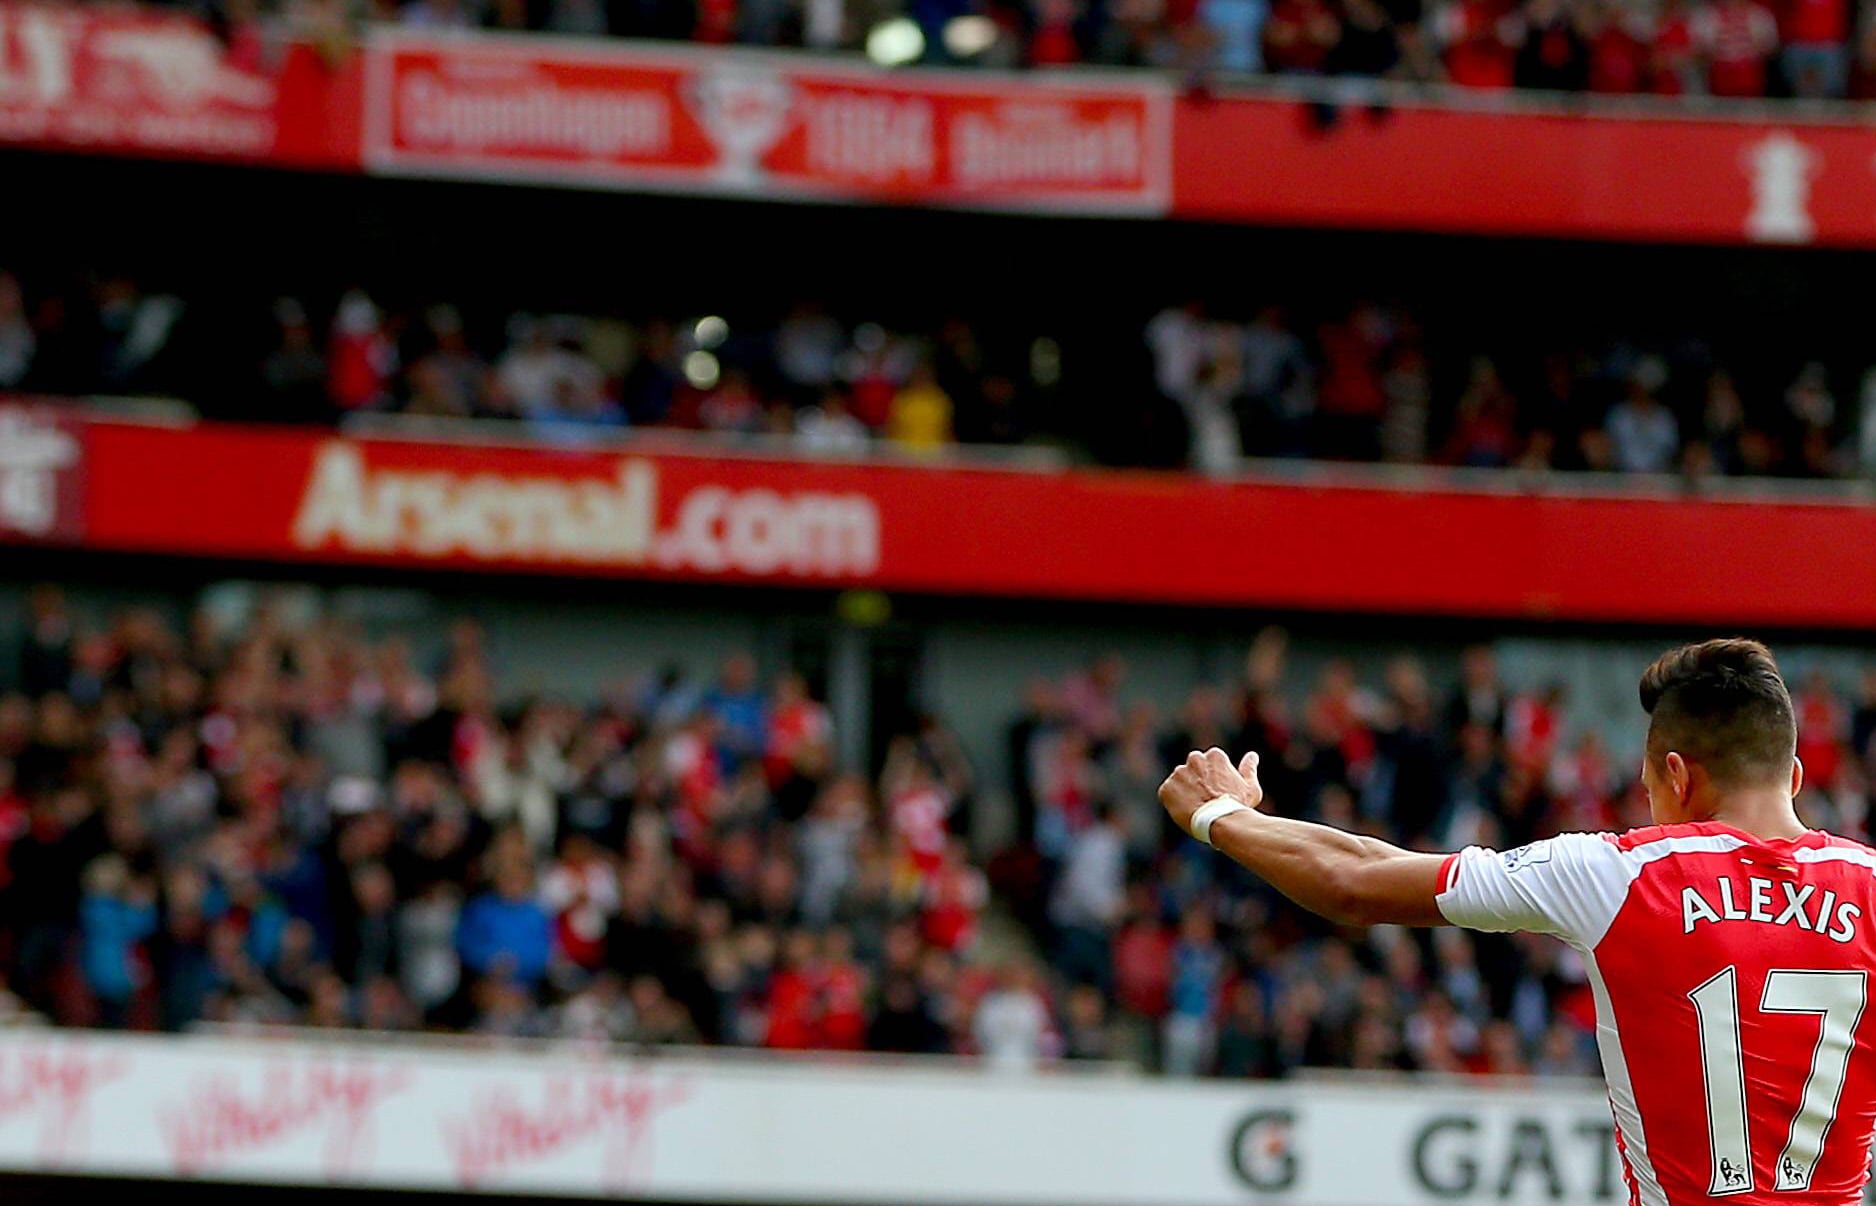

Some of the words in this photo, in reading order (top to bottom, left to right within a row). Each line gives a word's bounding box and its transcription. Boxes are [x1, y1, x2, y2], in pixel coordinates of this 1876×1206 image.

[293, 440, 880, 577] Arsenal.com
[1682, 876, 1861, 943] ALEXIS
[1687, 965, 1867, 1196] 17
